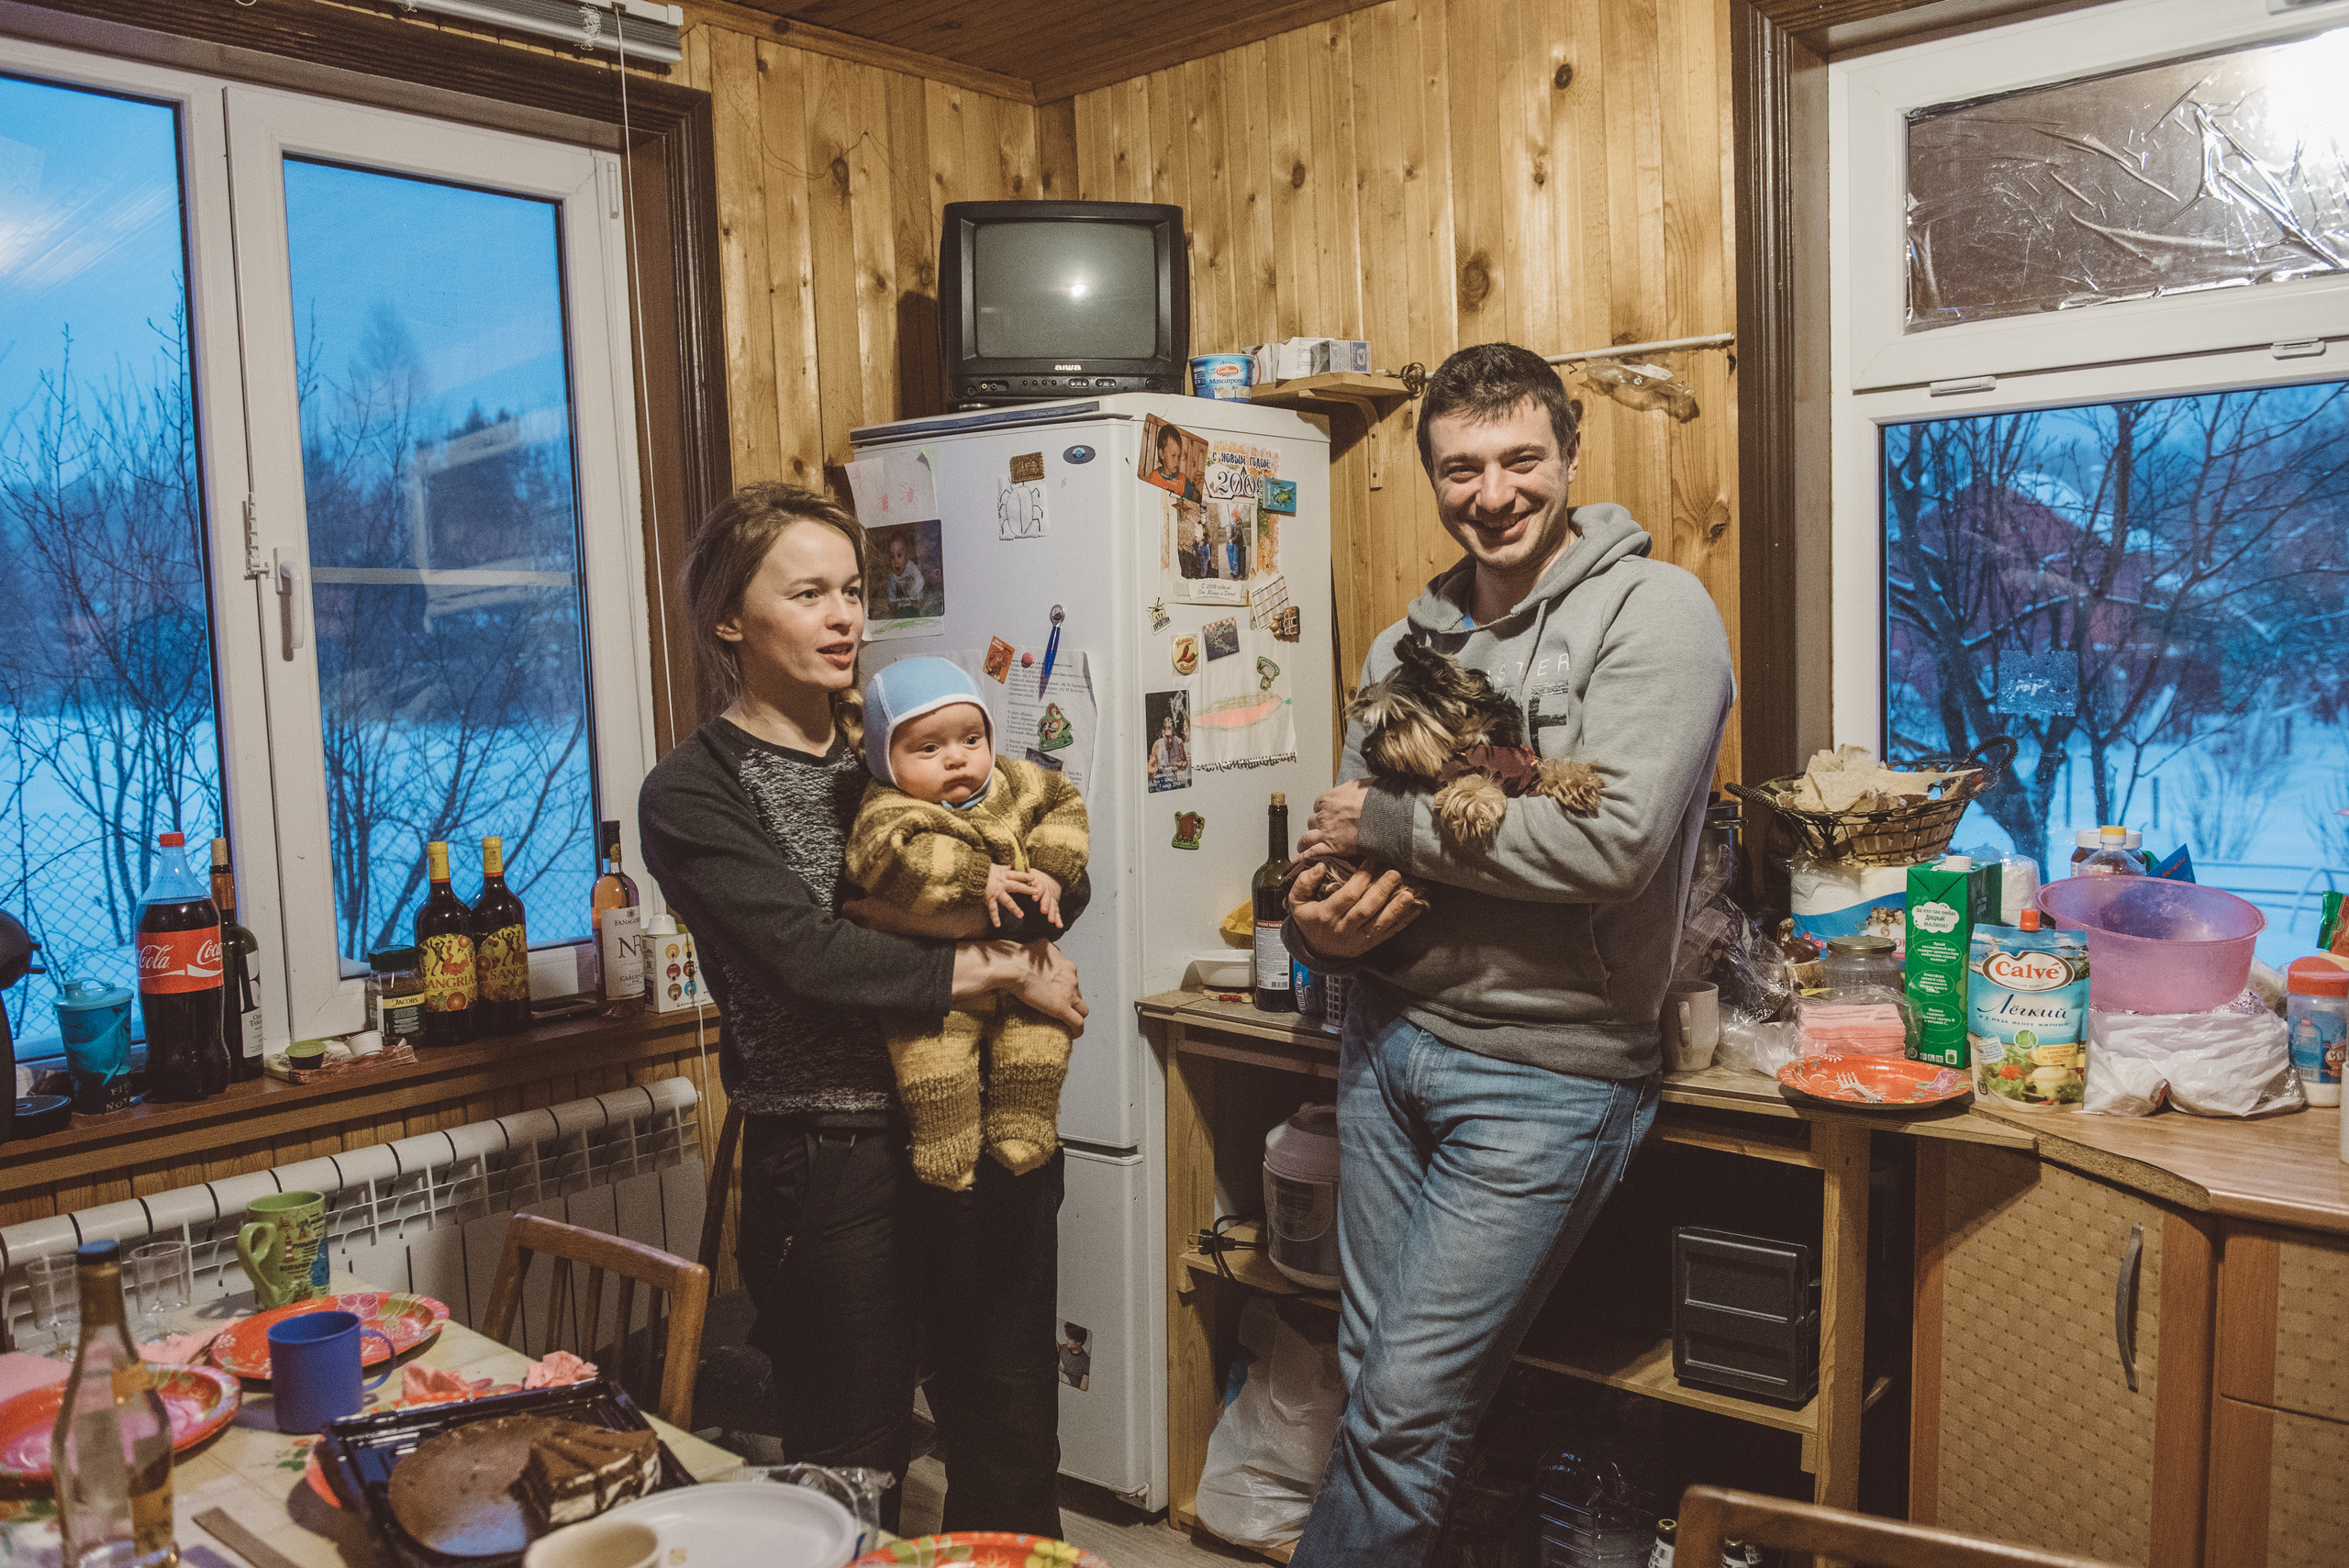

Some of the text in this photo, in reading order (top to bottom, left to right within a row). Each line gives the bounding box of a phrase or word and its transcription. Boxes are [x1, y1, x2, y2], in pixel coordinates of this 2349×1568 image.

[1220, 452, 1246, 465] НОВЫМ
[139, 944, 174, 969] Cola
[1995, 961, 2060, 979] Calvé
[422, 974, 474, 990] SANGRIA
[392, 997, 418, 1006] JACOBS
[1976, 994, 2066, 1019] Лёгкий
